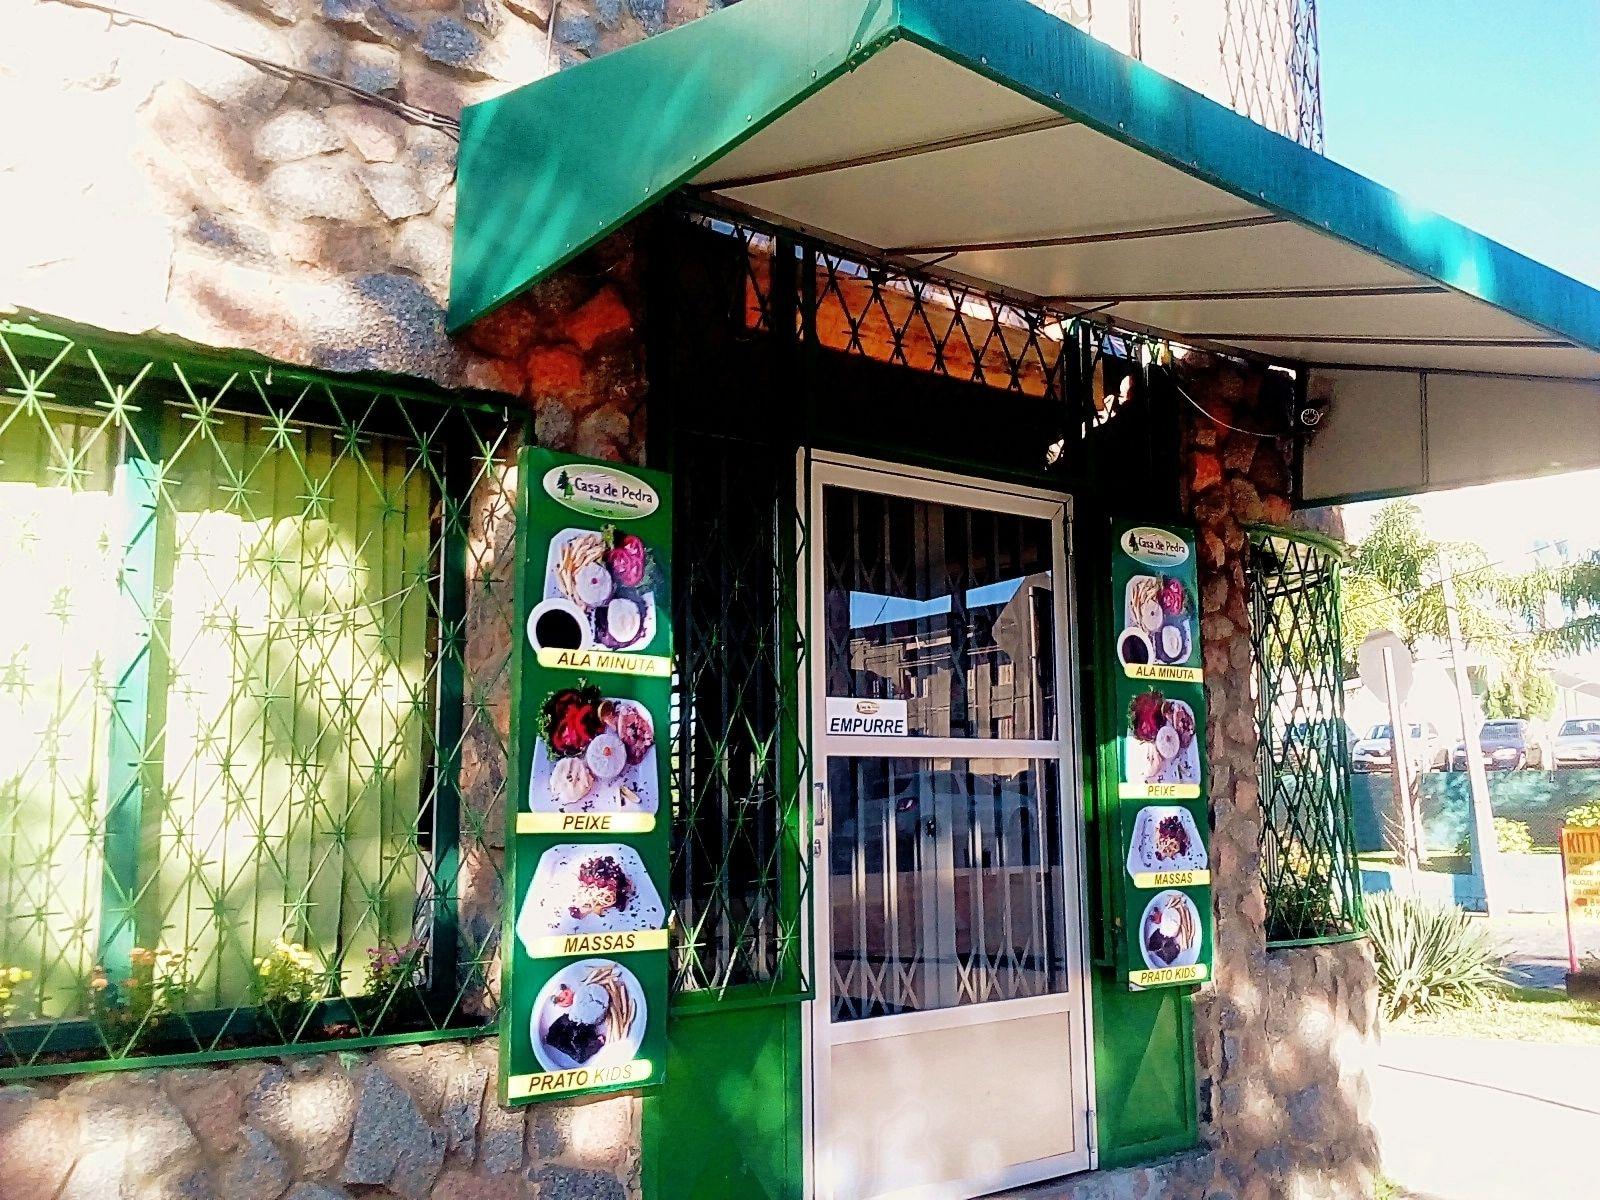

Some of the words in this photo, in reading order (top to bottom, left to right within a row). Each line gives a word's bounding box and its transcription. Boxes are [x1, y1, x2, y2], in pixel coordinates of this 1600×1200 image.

[574, 477, 600, 494] Casa
[603, 482, 618, 497] de
[621, 485, 653, 504] Pedra
[1138, 536, 1154, 549] Casa
[556, 651, 591, 667] ALA
[596, 655, 655, 672] MINUTA
[1135, 666, 1156, 677] ALA
[1158, 668, 1194, 680] MINUTA
[830, 717, 904, 734] EMPURRE
[1147, 785, 1176, 797] PEIXE
[562, 815, 612, 830] PEIXE
[1566, 832, 1600, 854] KITT
[1154, 872, 1193, 886] MASSAS
[563, 933, 636, 954] MASSAS
[1140, 969, 1173, 984] PRATO
[1174, 966, 1197, 980] KIDS
[528, 1070, 589, 1093] PRATO
[593, 1064, 632, 1084] KIDS
